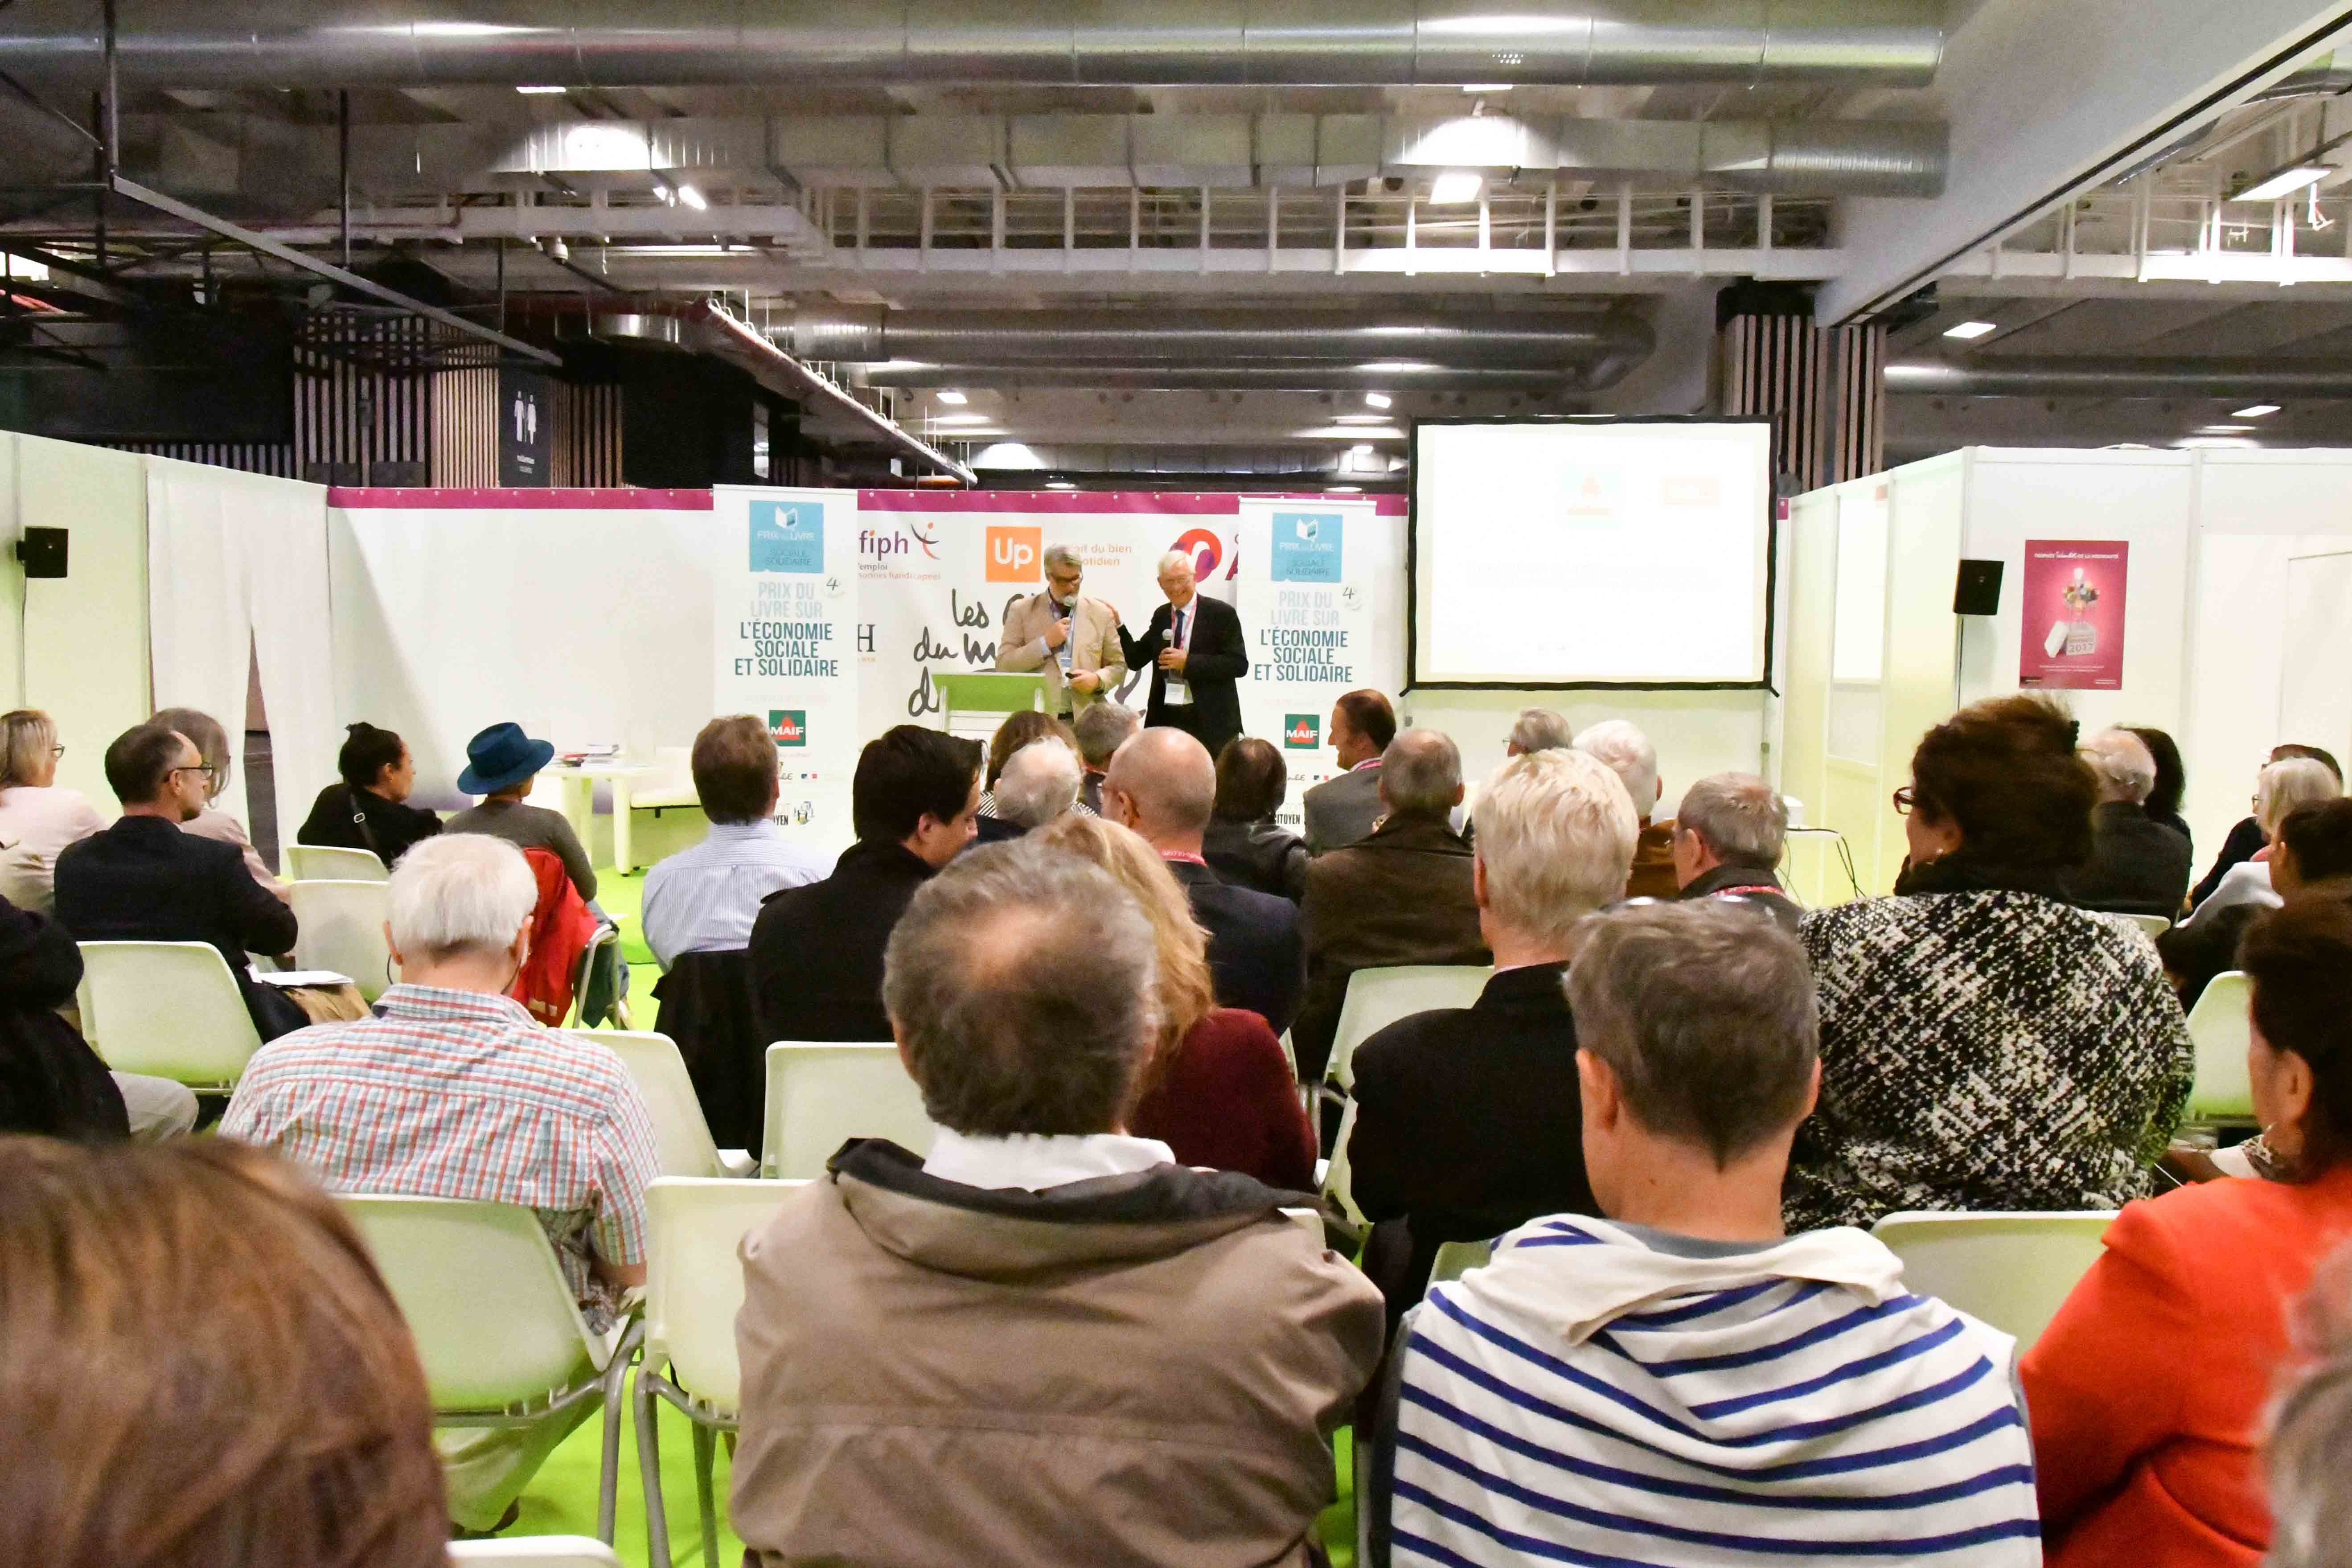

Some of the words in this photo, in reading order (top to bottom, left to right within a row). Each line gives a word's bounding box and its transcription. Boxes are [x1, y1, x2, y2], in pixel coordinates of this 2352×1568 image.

[994, 538, 1033, 570] Up
[1083, 557, 1120, 566] otidien
[759, 582, 791, 599] PRIX
[796, 583, 814, 600] DU
[1279, 591, 1310, 608] PRIX
[1314, 592, 1332, 608] DU
[751, 600, 791, 618] LIVRE
[795, 601, 822, 619] SUR
[1271, 609, 1308, 626] LIVRE
[1313, 610, 1340, 626] SUR
[740, 619, 833, 640] L'ÉCONOMIE
[1260, 626, 1348, 648] L'ÉCONOMIE
[754, 640, 819, 659] SOCIALE
[1273, 647, 1334, 665] SOCIALE
[735, 659, 755, 676] ET
[759, 660, 839, 677] SOLIDAIRE
[1254, 665, 1275, 681] ET
[1276, 665, 1353, 683] SOLIDAIRE
[771, 727, 804, 735] MAIF
[1286, 729, 1318, 739] MAIF
[1277, 813, 1301, 824] ITOYEN
